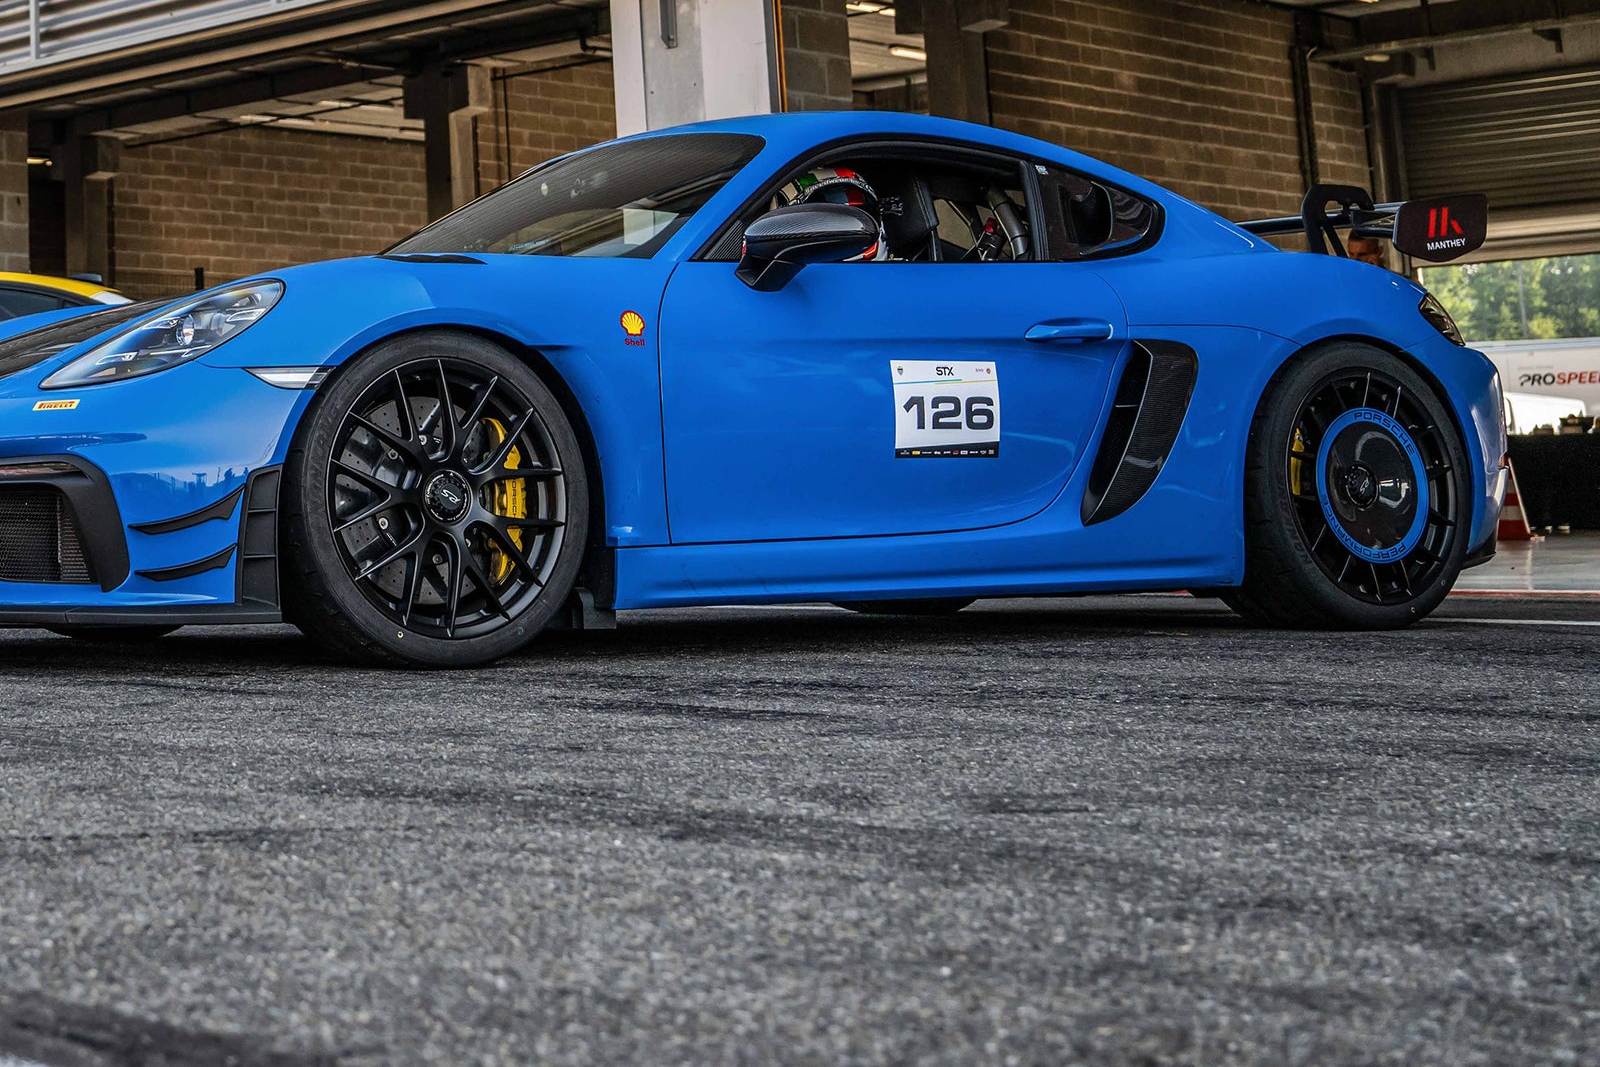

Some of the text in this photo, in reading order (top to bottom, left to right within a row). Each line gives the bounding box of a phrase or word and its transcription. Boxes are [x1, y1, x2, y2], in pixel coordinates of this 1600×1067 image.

[1427, 238, 1466, 251] MANTHEY
[625, 338, 645, 346] Shell
[935, 366, 954, 376] STX
[1519, 371, 1600, 386] PROSPEE
[37, 401, 75, 410] PIRELLI
[903, 396, 994, 430] 126
[1354, 412, 1415, 455] PORSCHE
